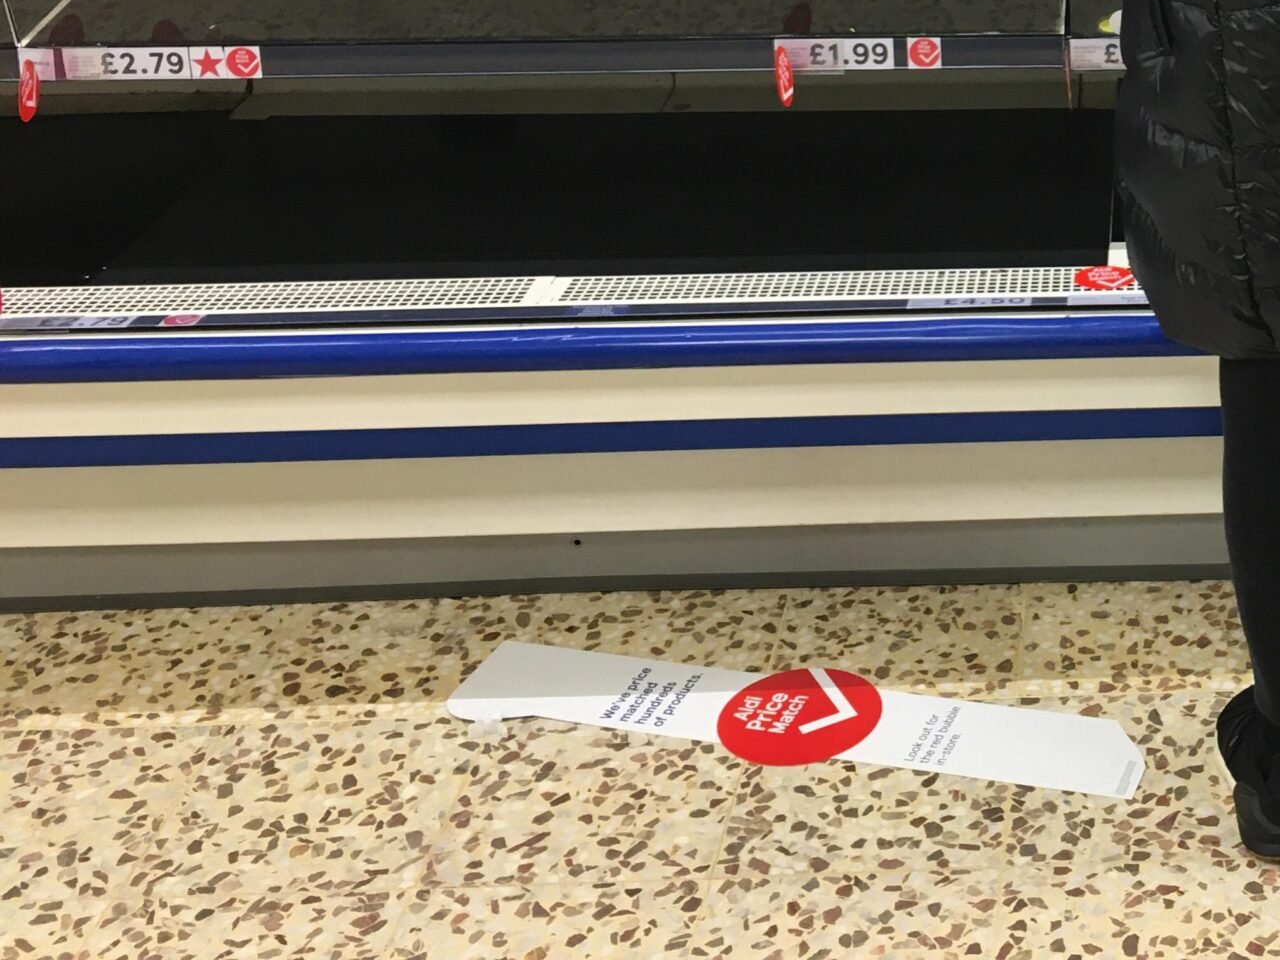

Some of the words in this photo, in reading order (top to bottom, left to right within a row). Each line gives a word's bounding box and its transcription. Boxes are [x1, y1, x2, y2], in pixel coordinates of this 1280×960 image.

[101, 52, 184, 75] £2.79
[809, 43, 889, 65] £1.99
[943, 297, 1026, 306] £4.50
[599, 692, 632, 719] We've
[627, 667, 653, 691] price
[619, 681, 658, 722] matched
[633, 681, 677, 725] hundreds
[654, 716, 667, 727] of
[663, 673, 704, 716] products.
[733, 695, 764, 722] Aldi
[745, 692, 789, 731] Price
[767, 695, 809, 734] Match
[925, 714, 940, 726] for
[918, 727, 934, 741] out
[919, 750, 935, 763] the
[930, 734, 944, 749] red
[937, 706, 961, 733] bubble
[933, 732, 962, 766] in-store.
[903, 742, 923, 762] Look
